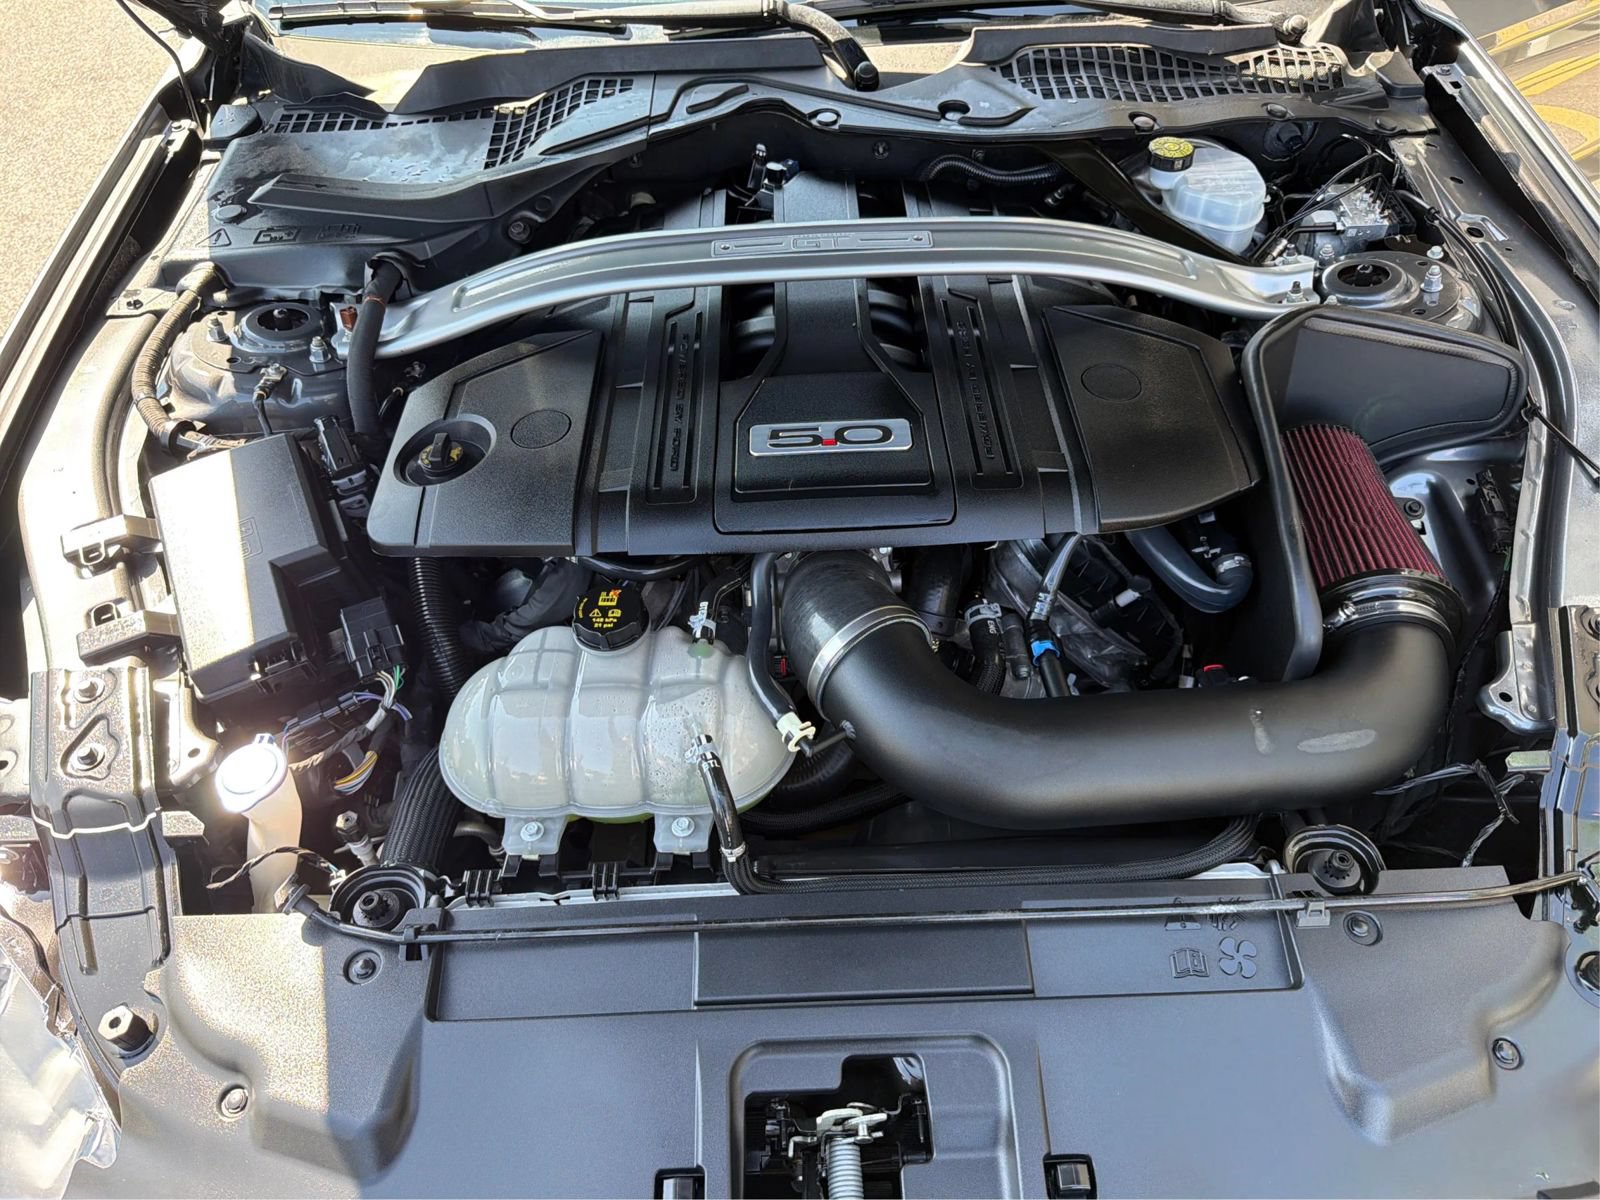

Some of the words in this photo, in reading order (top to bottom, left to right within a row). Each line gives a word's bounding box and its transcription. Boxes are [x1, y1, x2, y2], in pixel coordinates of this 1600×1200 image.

[791, 236, 852, 250] GT
[767, 424, 895, 449] 5.0
[670, 428, 682, 471] FORD
